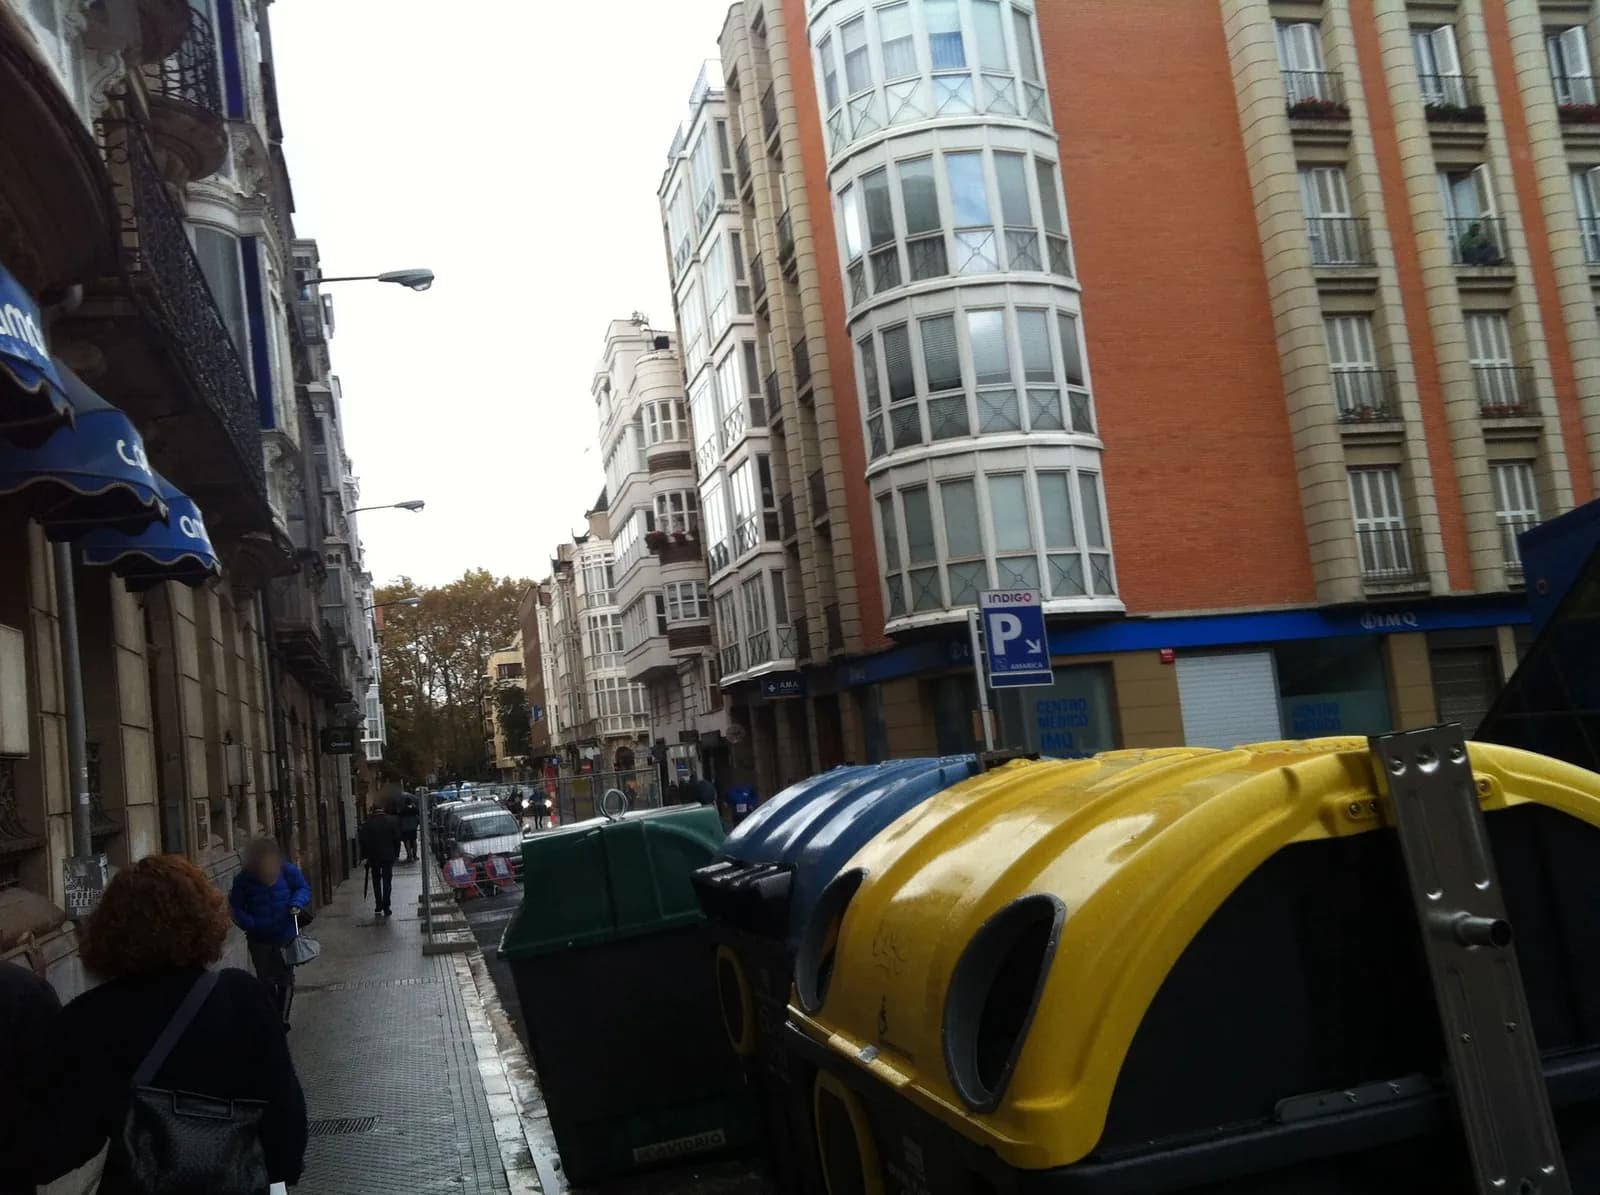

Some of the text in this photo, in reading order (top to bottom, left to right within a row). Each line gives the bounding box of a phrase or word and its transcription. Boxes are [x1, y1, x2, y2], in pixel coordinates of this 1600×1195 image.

[988, 592, 1032, 604] INDIGO
[1378, 611, 1419, 627] IMQ
[988, 612, 1023, 656] P
